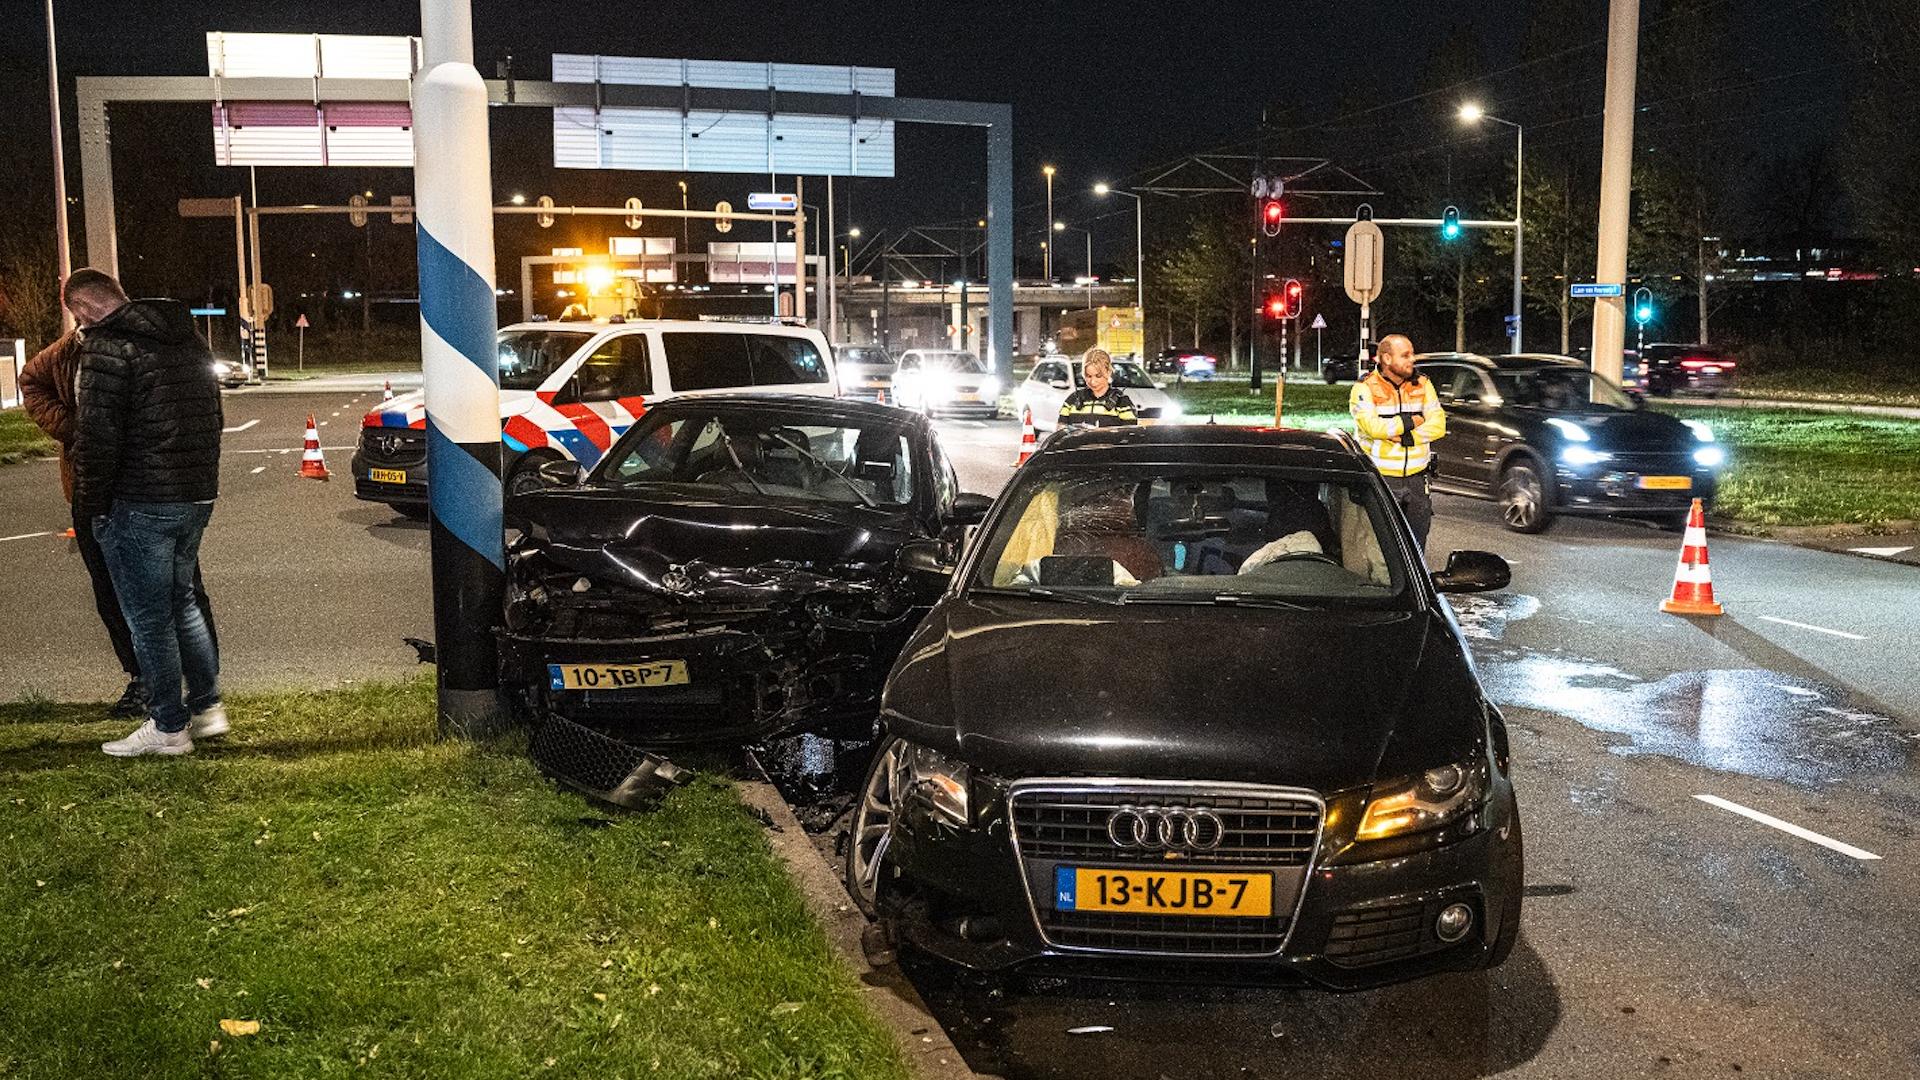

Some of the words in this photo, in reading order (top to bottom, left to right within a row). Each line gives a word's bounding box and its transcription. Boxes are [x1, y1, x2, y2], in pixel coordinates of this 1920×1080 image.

[573, 665, 672, 687] 10-TBP-7
[1060, 892, 1073, 902] NL
[1096, 875, 1249, 909] 13-KJB-7
